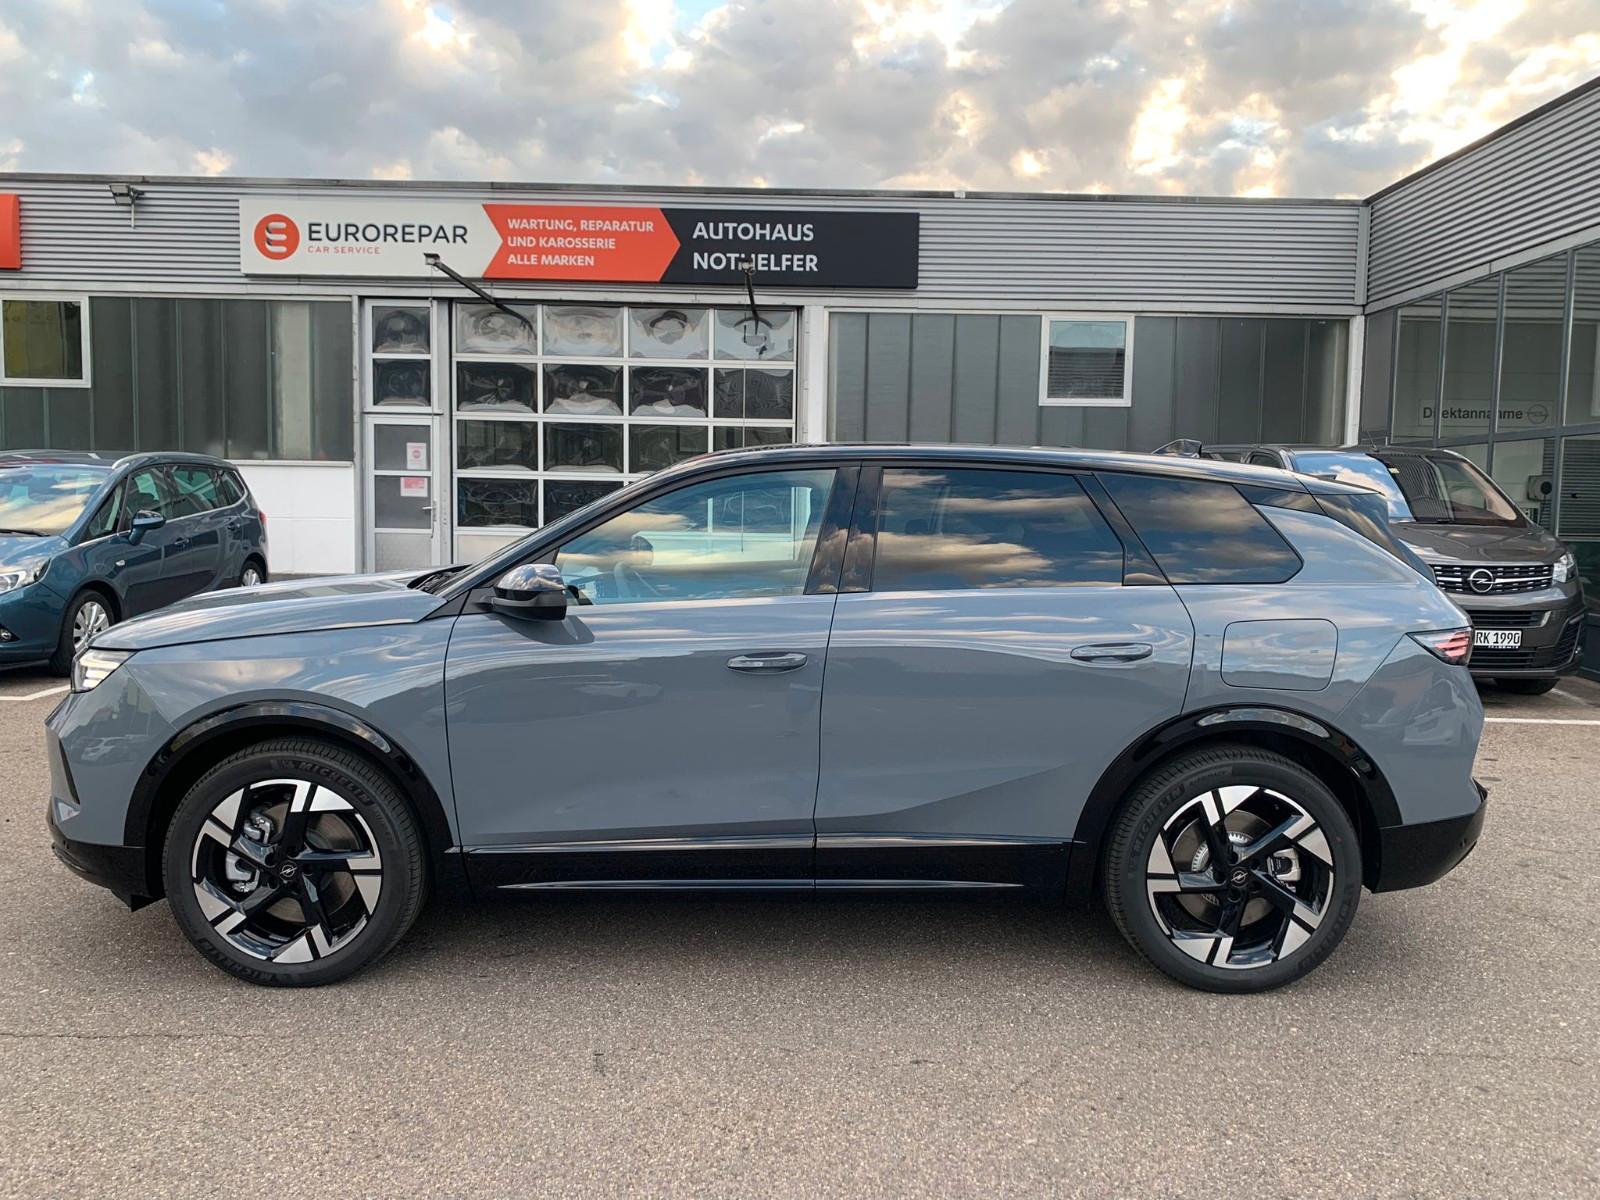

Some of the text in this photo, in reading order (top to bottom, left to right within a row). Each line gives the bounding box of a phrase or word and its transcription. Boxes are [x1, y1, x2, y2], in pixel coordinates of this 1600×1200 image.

[507, 218, 654, 232] WARTUNG, REPARATUR
[308, 223, 468, 244] EUROREPAR
[692, 222, 814, 242] AUTOHAUS
[507, 236, 616, 249] UND KAROSSERIE
[307, 245, 381, 255] CAR SERVICE
[507, 254, 594, 266] ALLE MARKEN
[1475, 632, 1520, 645] RK 1990
